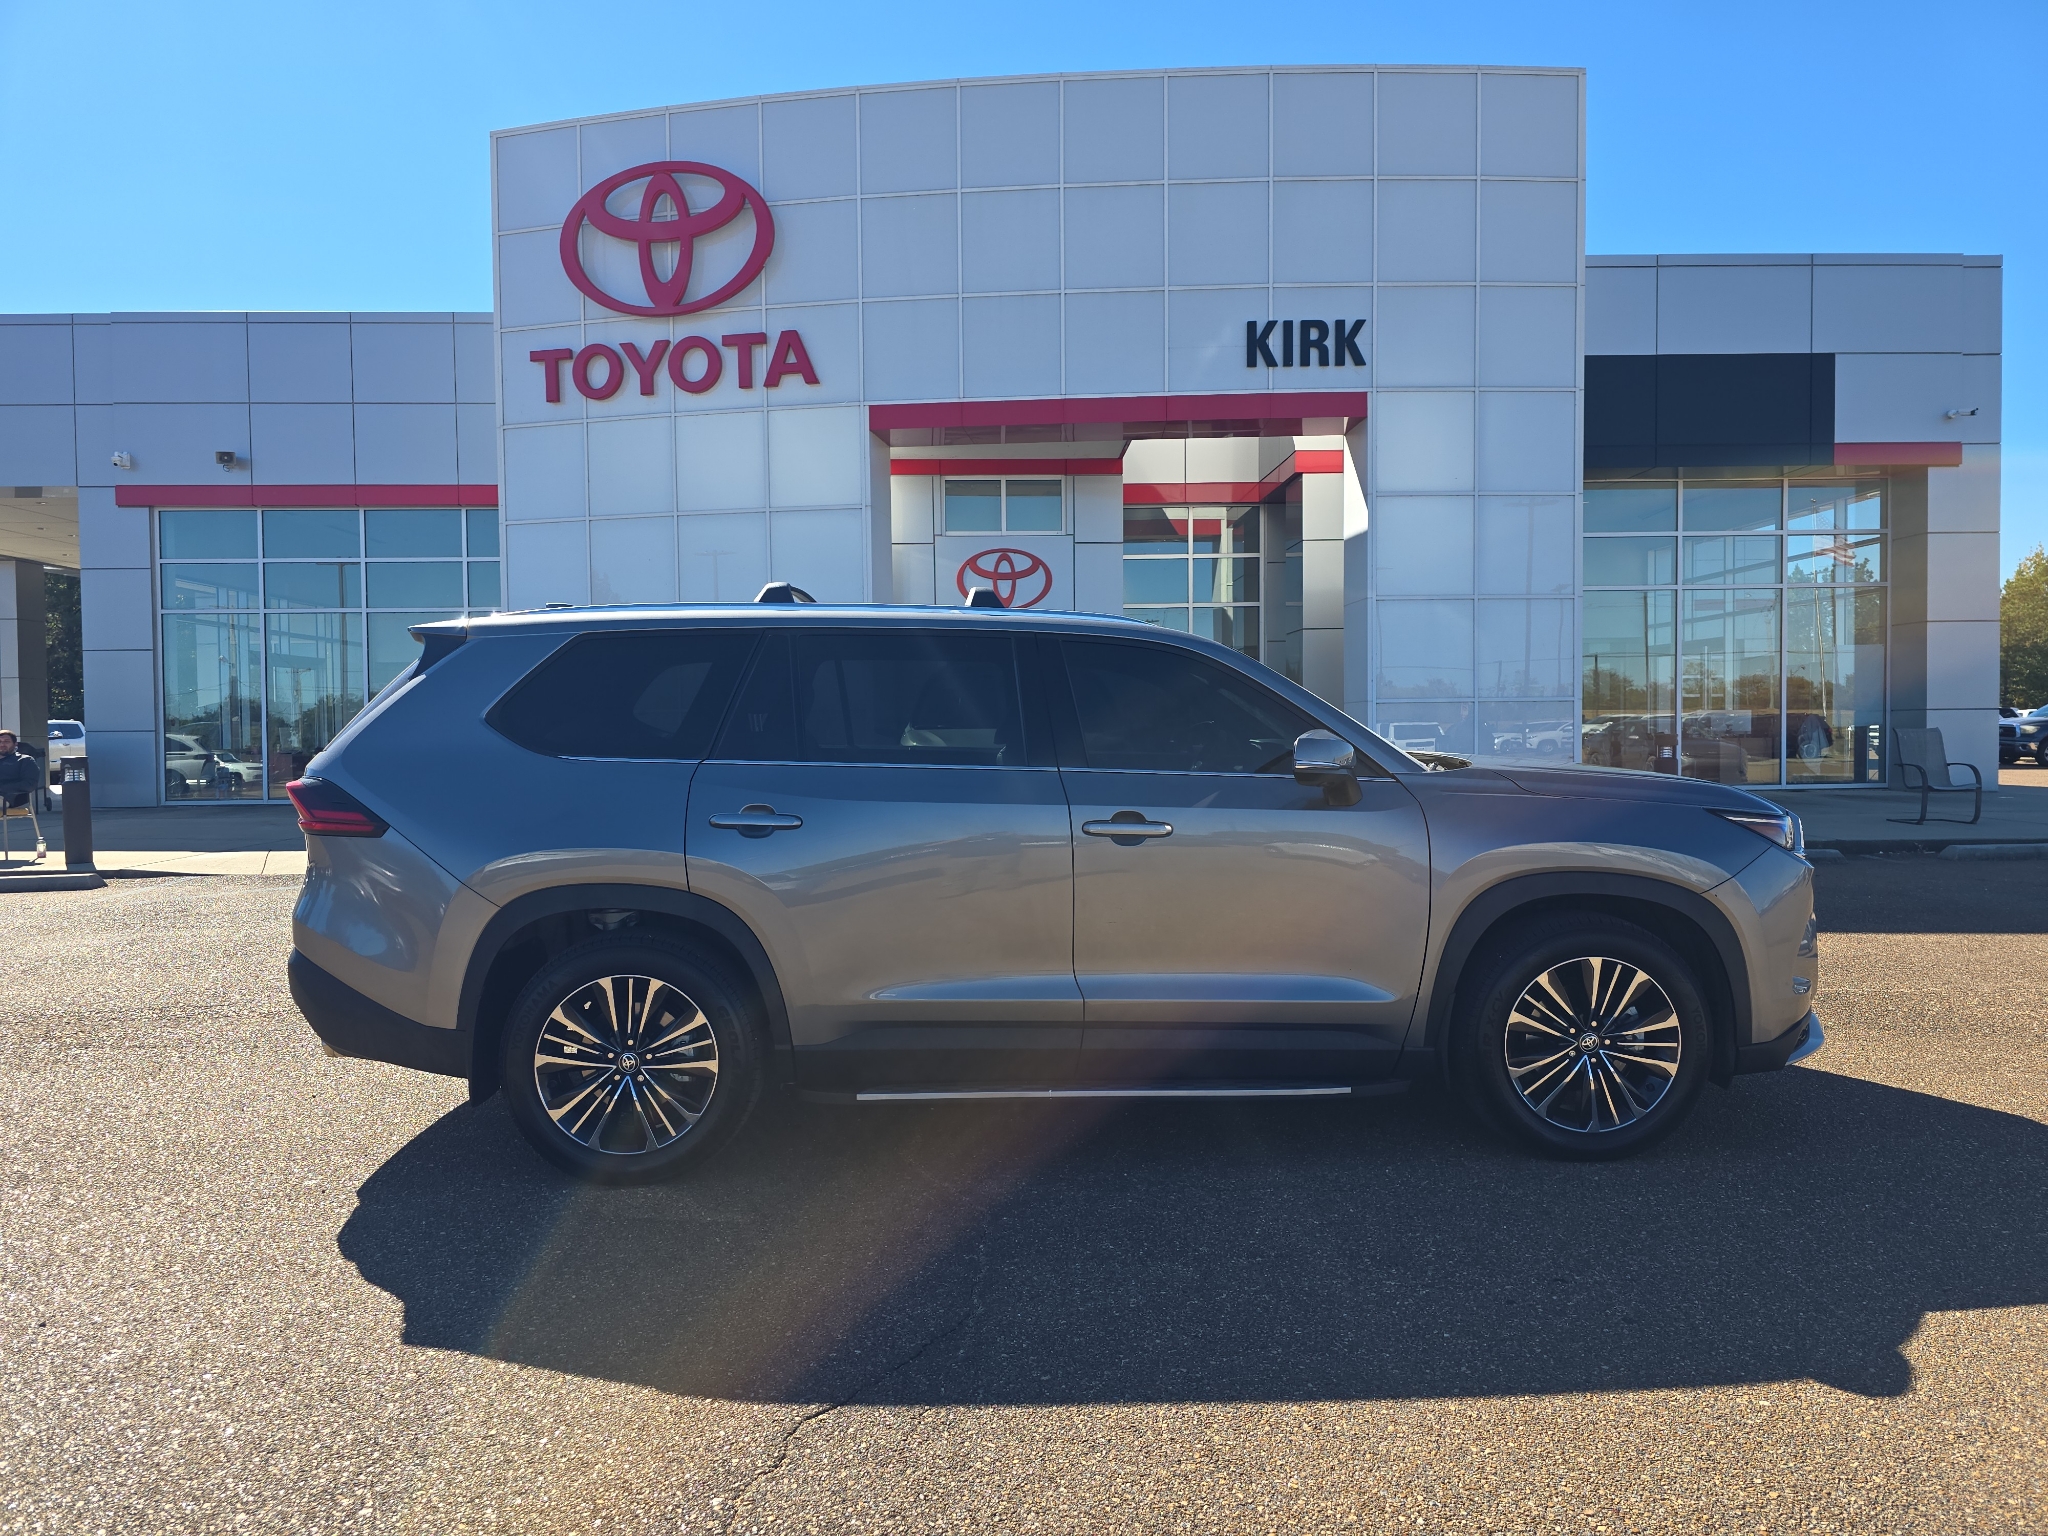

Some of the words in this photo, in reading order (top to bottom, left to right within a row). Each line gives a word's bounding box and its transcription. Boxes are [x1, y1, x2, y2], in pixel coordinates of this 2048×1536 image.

[529, 330, 820, 403] TOYOTA
[1247, 319, 1366, 367] KIRK
[510, 980, 559, 1052] YOKOHAMA
